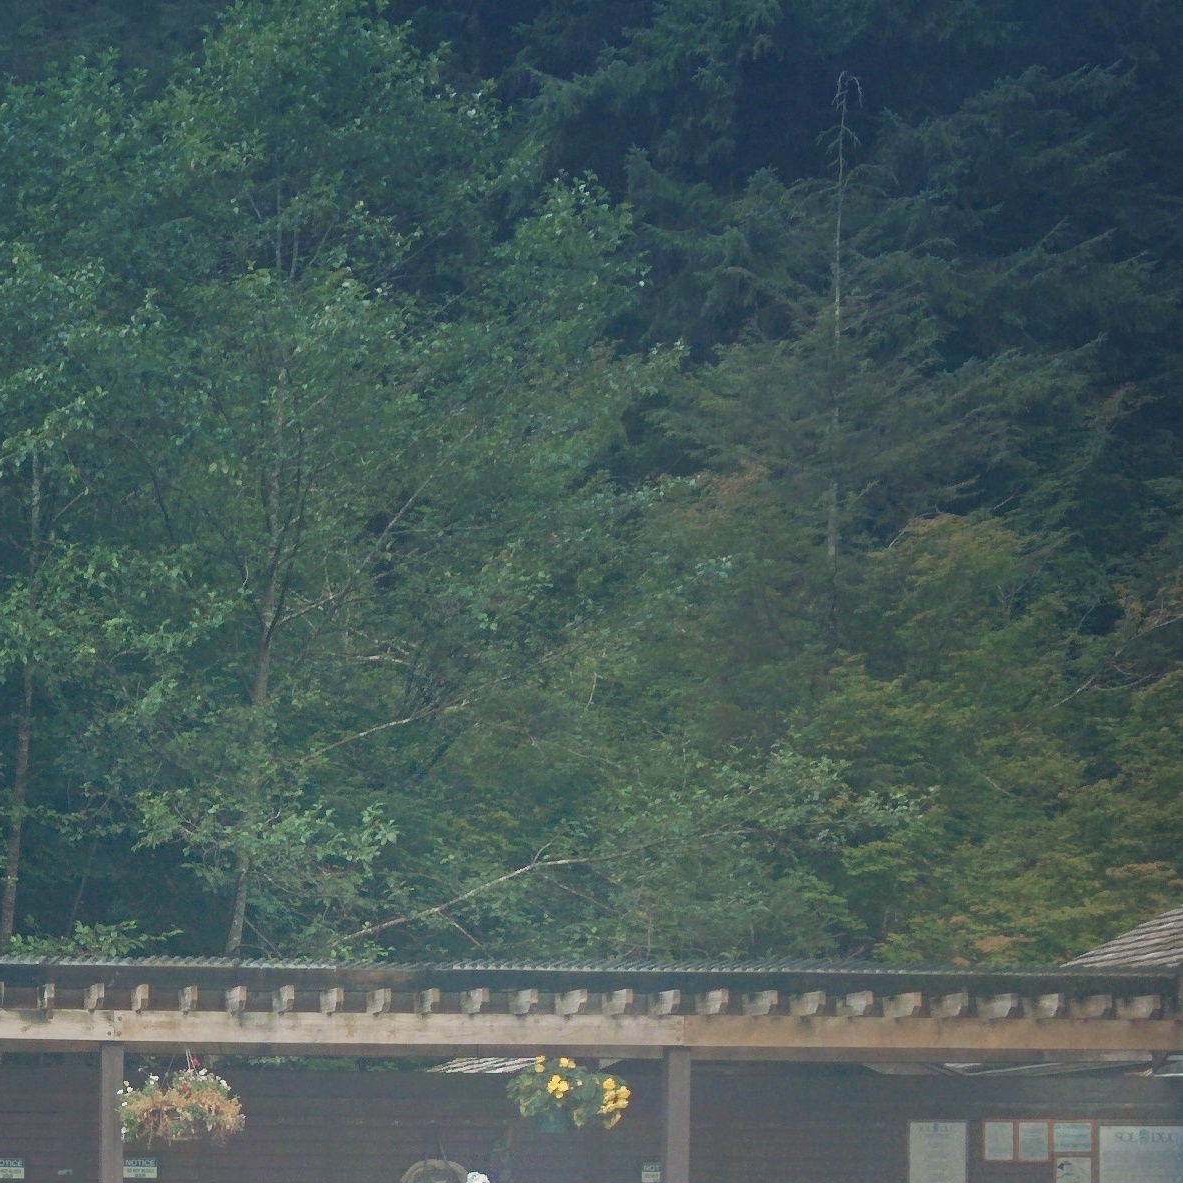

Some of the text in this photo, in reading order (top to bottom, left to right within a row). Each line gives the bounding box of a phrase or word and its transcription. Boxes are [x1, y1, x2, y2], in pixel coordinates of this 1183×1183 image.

[1115, 1131, 1179, 1143] SOL DUC
[125, 1159, 156, 1167] NOTICE
